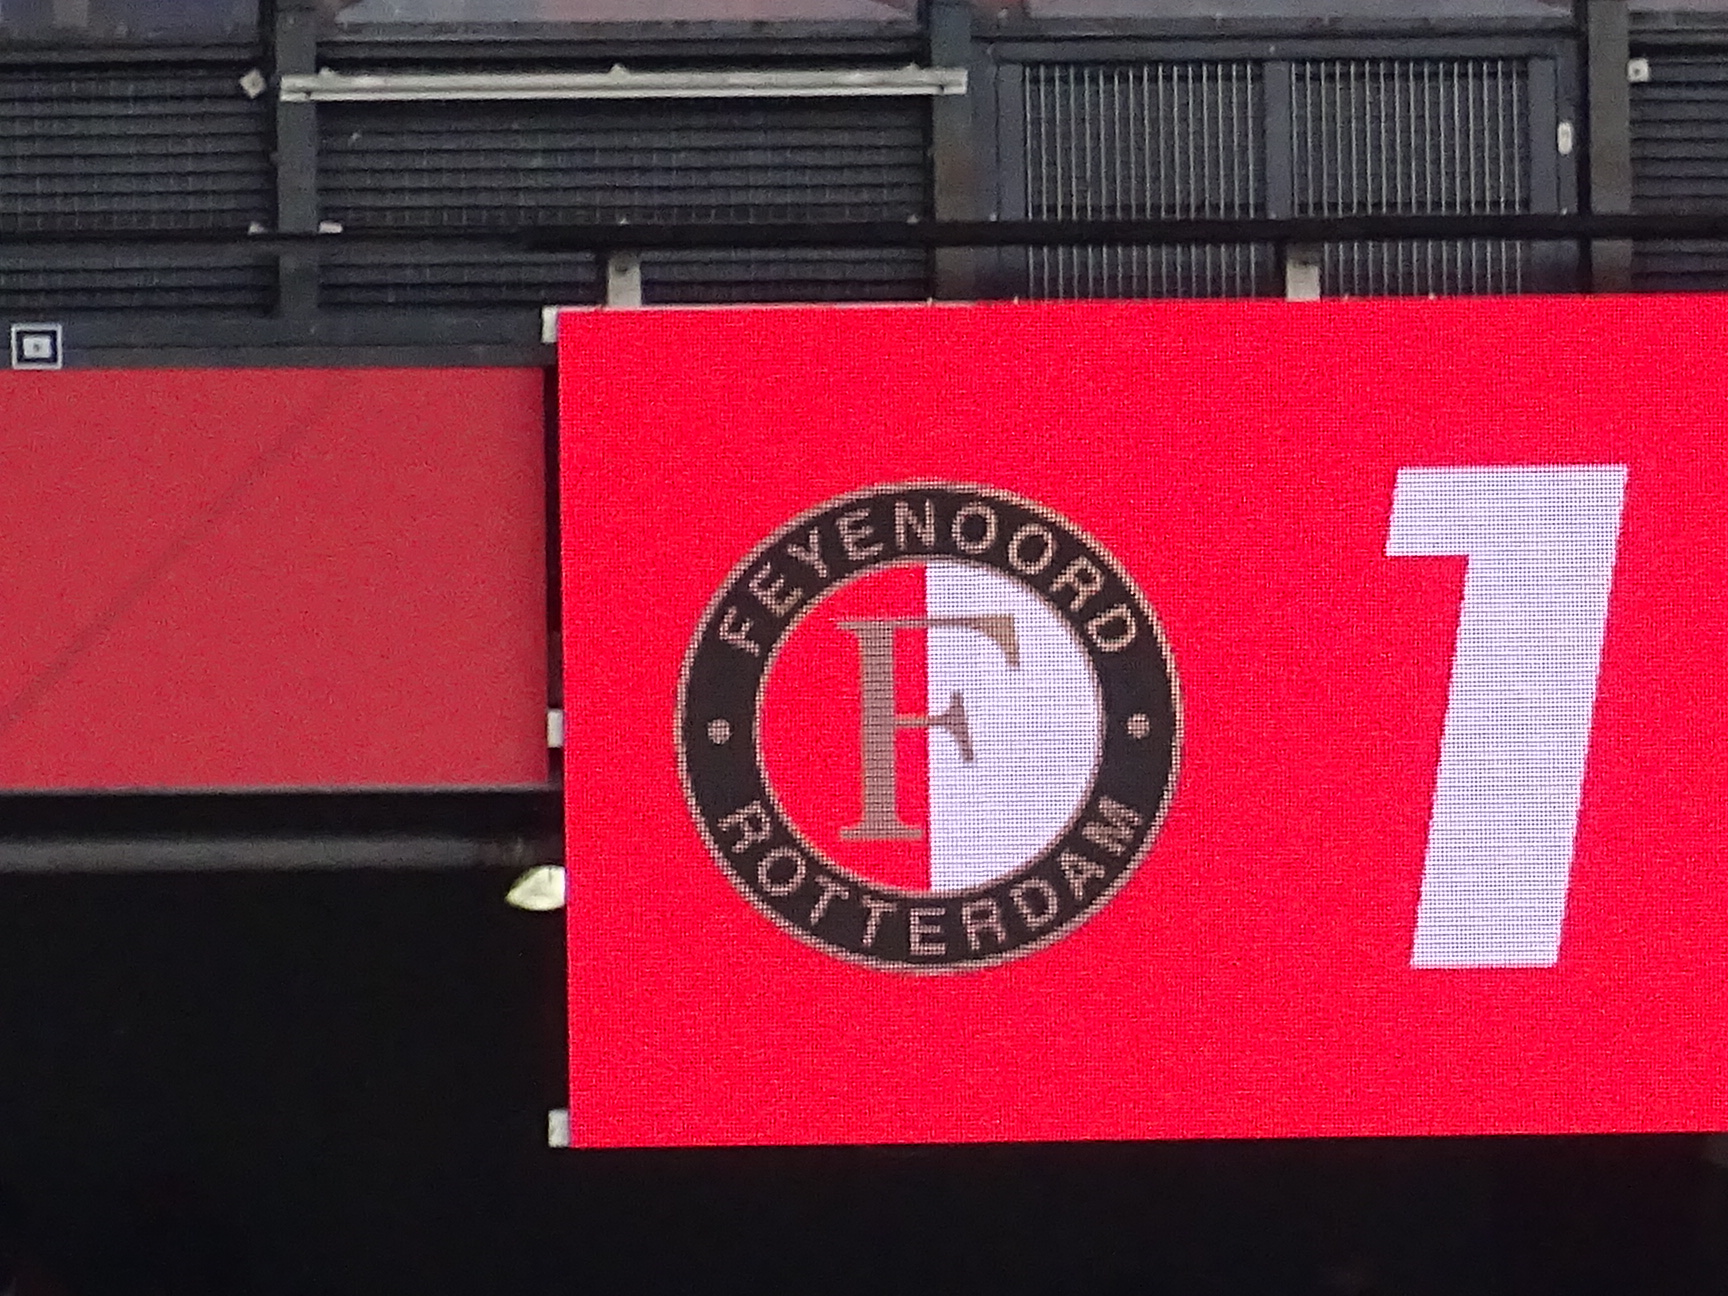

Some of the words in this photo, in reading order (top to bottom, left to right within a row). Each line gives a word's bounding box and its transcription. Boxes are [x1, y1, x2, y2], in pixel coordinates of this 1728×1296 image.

[718, 498, 1138, 656] FEYENOORD
[835, 612, 1022, 842] F
[1385, 463, 1629, 969] 1
[717, 795, 1142, 959] ROTTERDAM
